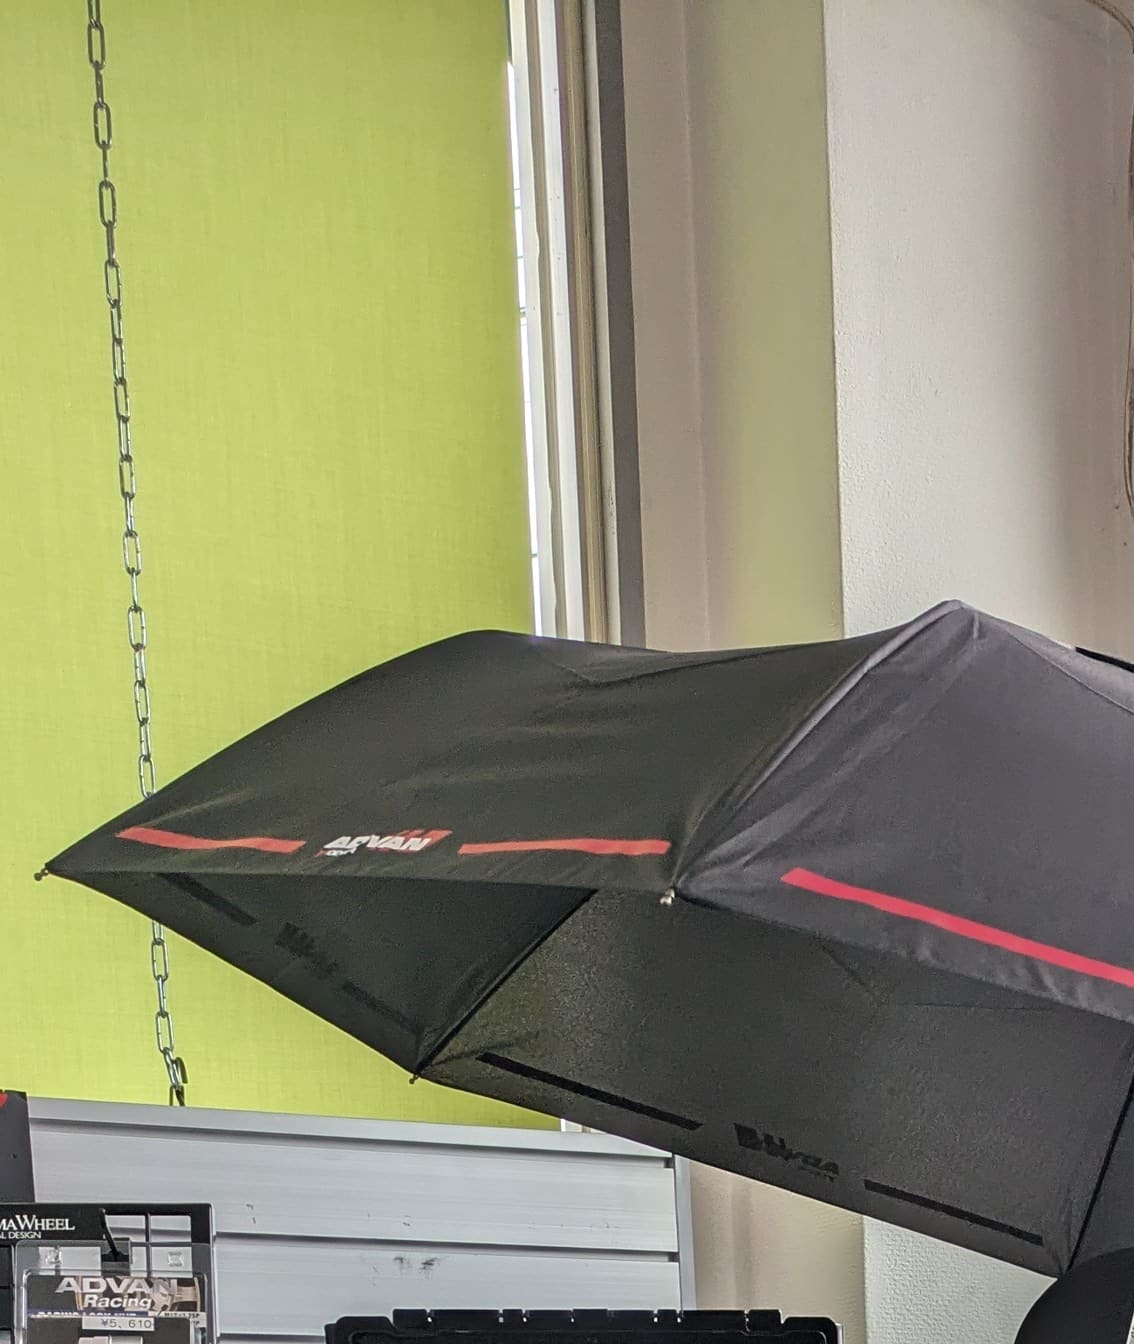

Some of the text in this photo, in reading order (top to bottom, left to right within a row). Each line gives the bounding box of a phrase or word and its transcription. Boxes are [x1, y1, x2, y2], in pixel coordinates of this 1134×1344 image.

[323, 834, 432, 852] ADVAN
[8, 1231, 42, 1240] DESIGN
[54, 1277, 178, 1294] ADVAN
[83, 1294, 152, 1309] Racing
